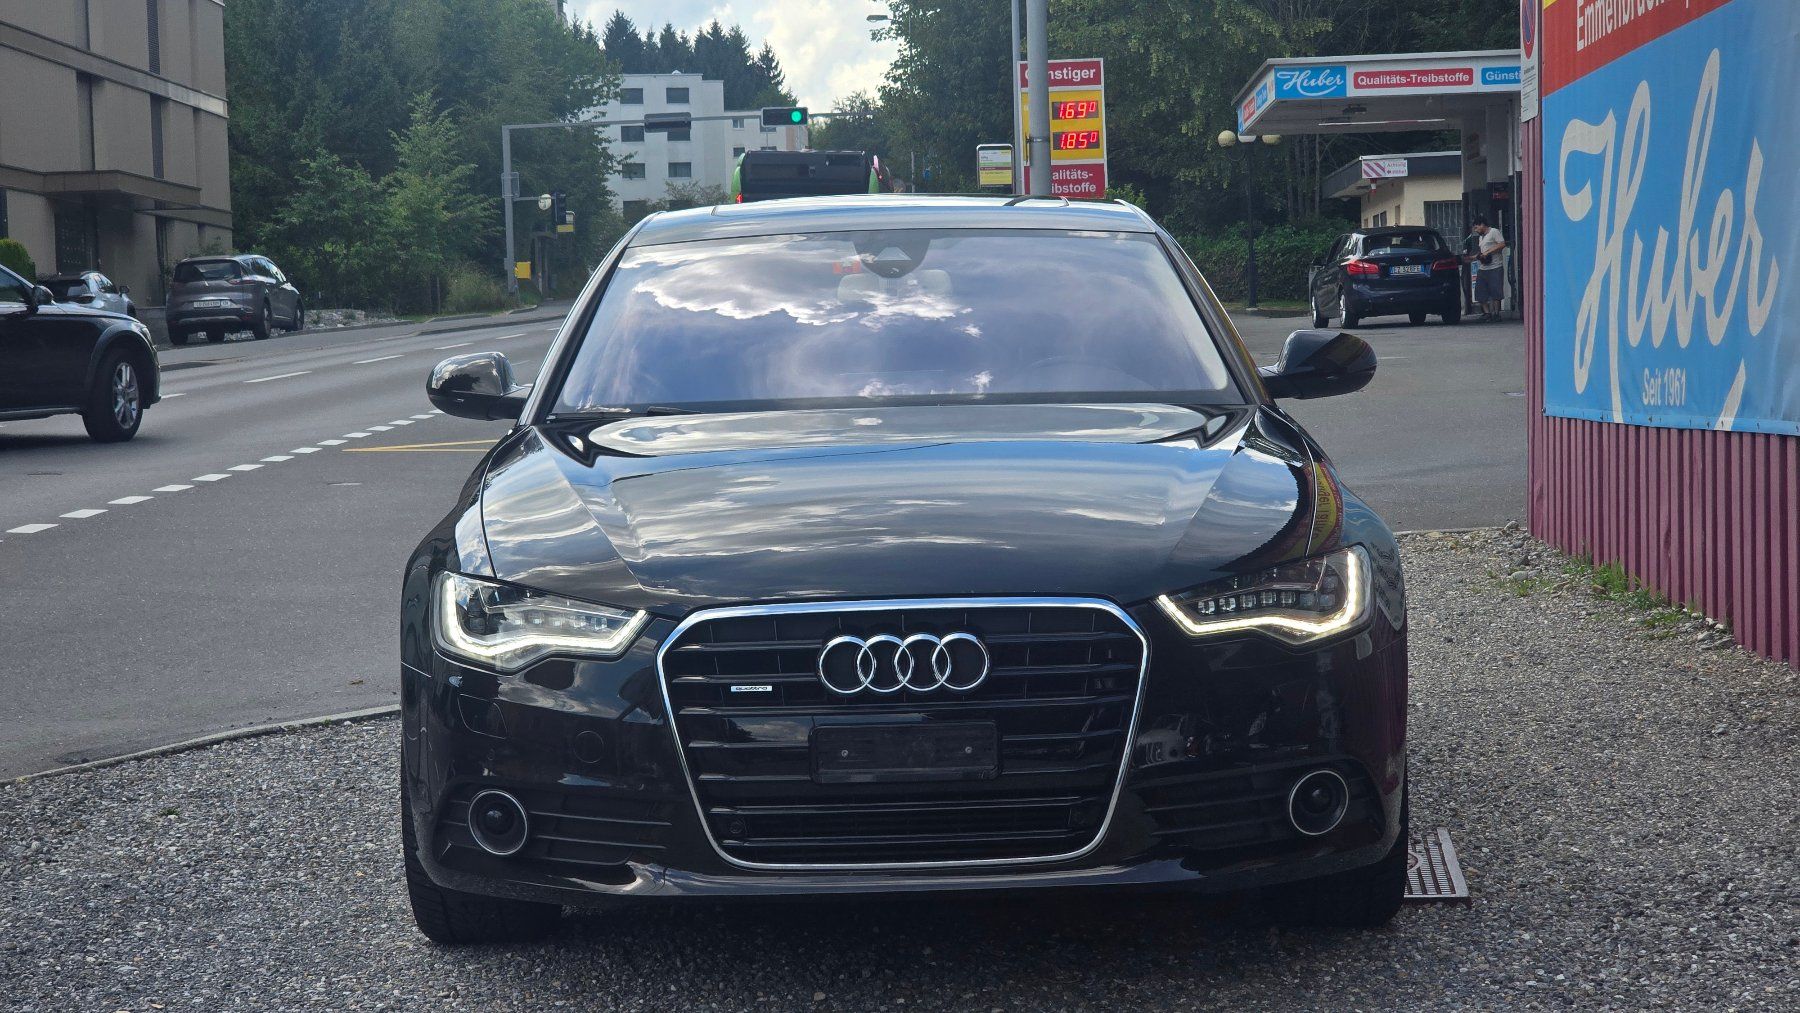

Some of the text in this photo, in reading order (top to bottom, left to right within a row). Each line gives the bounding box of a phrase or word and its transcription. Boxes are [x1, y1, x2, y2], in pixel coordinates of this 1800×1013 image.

[1025, 67, 1096, 82] nstiger
[1357, 72, 1470, 86] Qualitäts-Treibstoffe
[1485, 70, 1521, 81] Günsti
[1277, 69, 1344, 96] Huber
[1052, 169, 1094, 180] alitäts-
[1051, 182, 1097, 194] ibstoffe
[1559, 48, 1780, 430] Huber
[1642, 367, 1686, 407] Seit 1961
